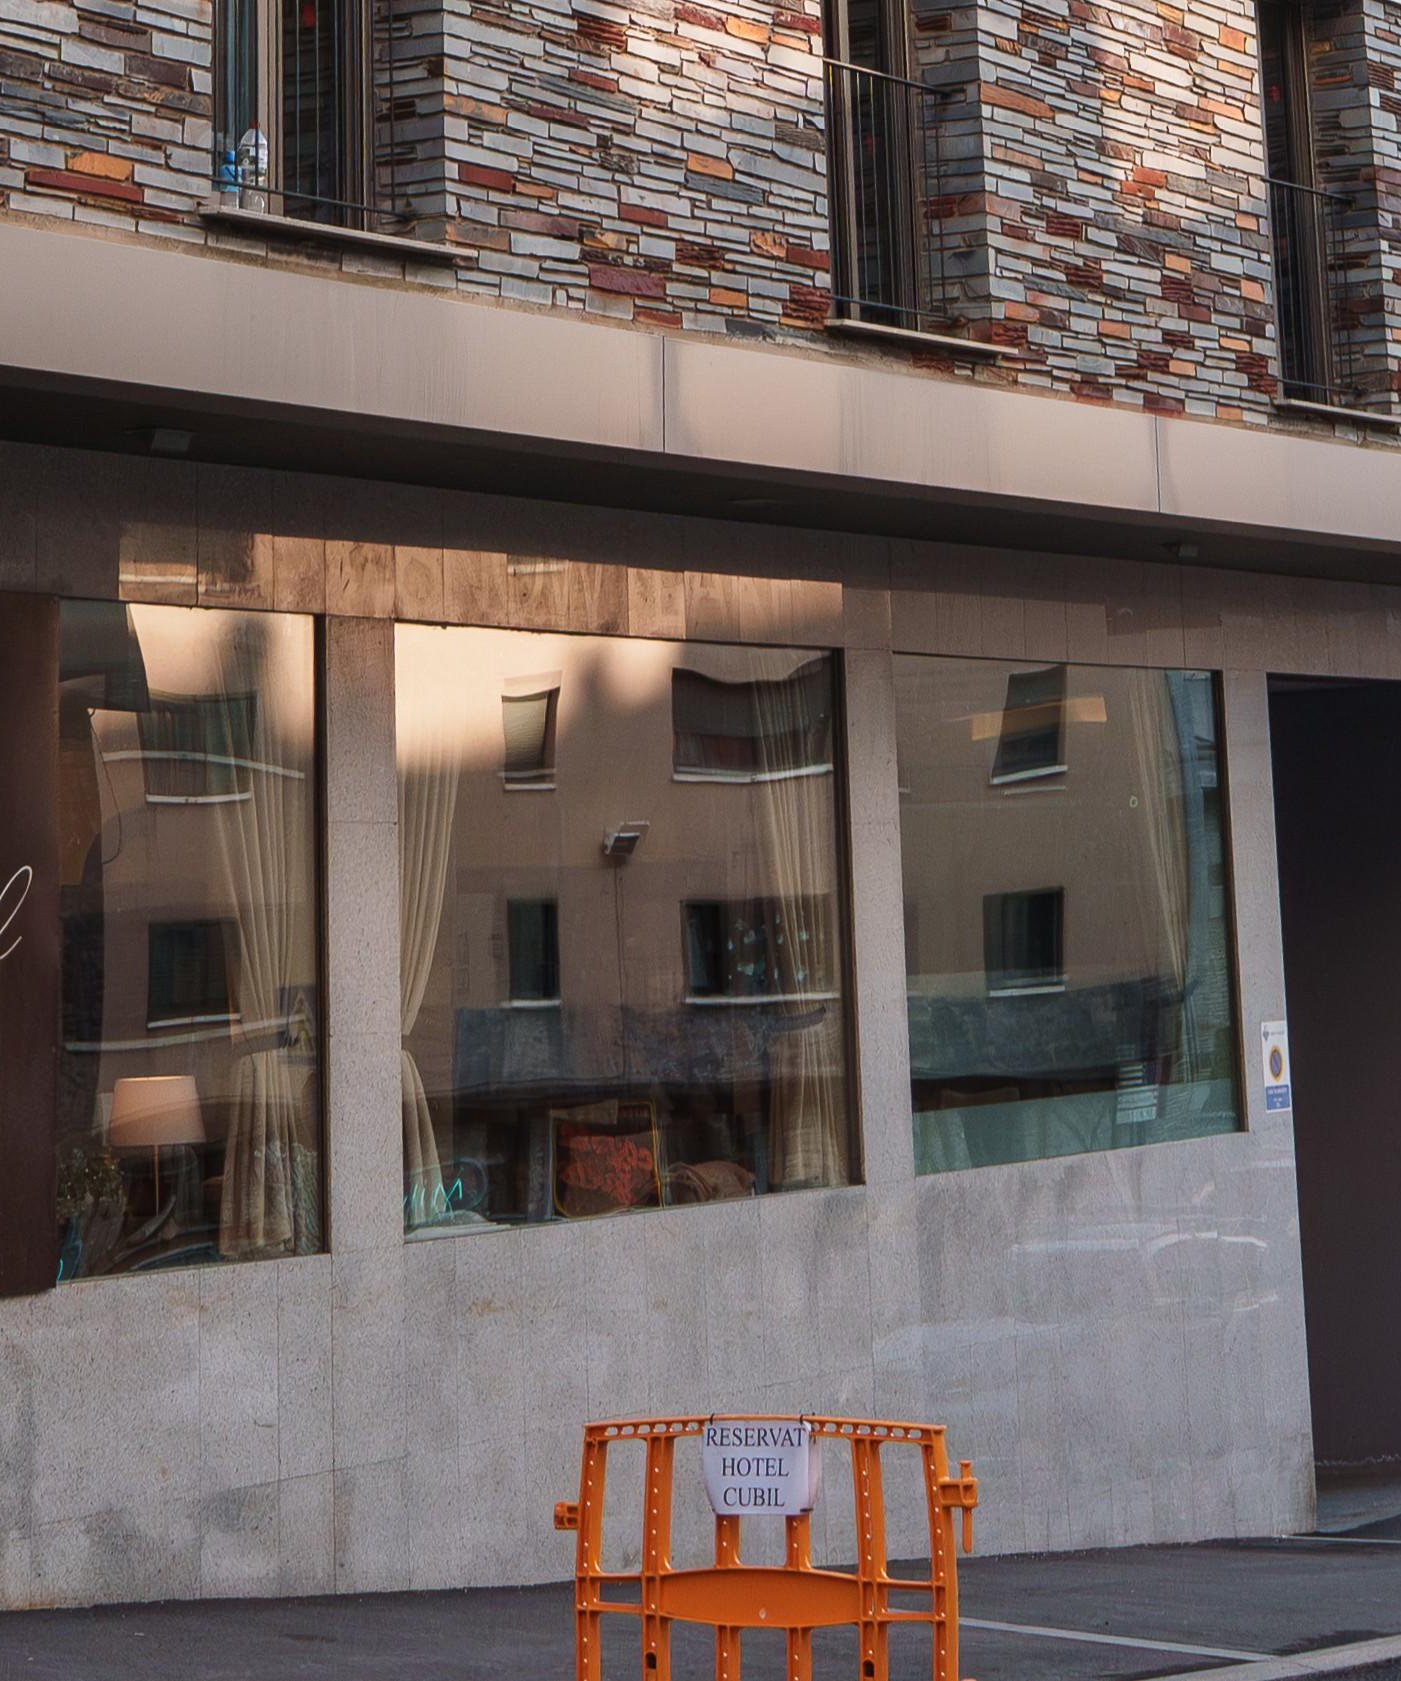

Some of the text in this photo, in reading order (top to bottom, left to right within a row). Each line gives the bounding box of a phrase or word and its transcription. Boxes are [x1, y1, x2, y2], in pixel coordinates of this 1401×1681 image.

[706, 1426, 807, 1448] RESERVAT
[722, 1457, 789, 1477] HOTEL
[723, 1486, 785, 1507] CUBIL
